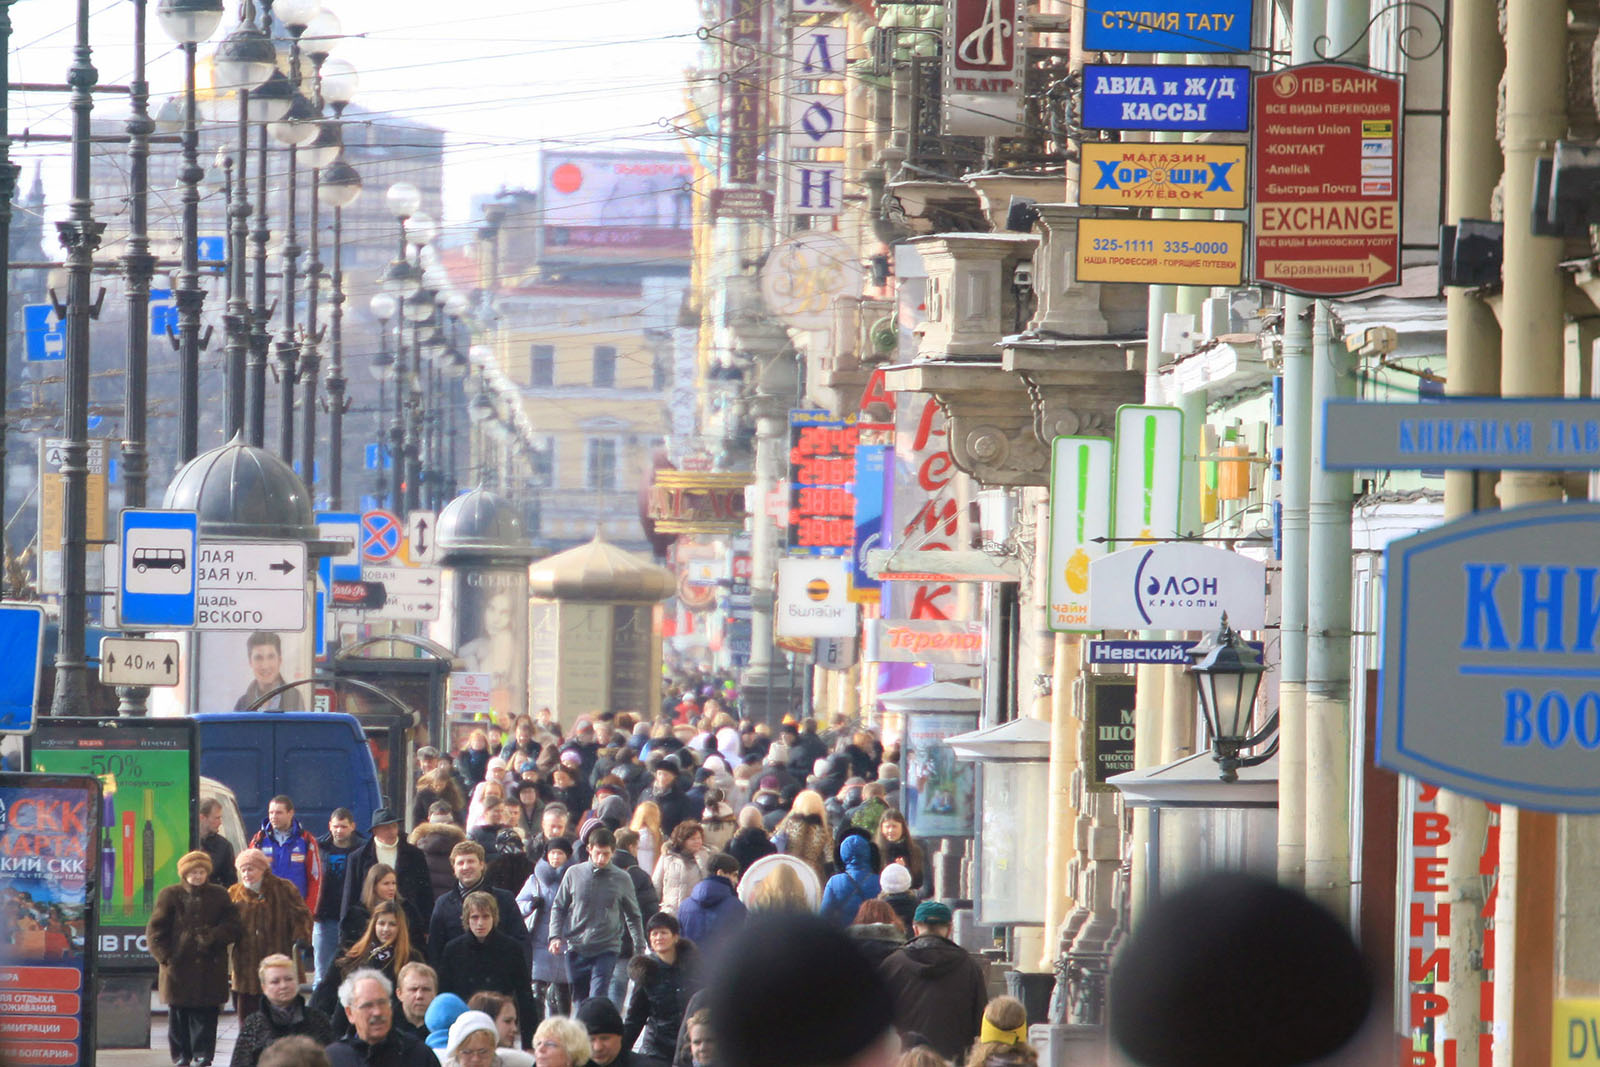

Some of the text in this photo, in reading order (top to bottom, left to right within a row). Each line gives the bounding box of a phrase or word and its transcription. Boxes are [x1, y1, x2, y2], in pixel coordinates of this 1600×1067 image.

[1102, 11, 1235, 33] СТУДИЯ ТАТУ
[954, 78, 1014, 93] ТЕАТР
[1094, 77, 1236, 100] АВИА и Ж/Д
[1301, 78, 1378, 93] ПВ-БАНК
[797, 0, 834, 208] ЛОН
[1265, 104, 1287, 114] ВСЕ
[1289, 104, 1322, 115] ВИДЫ
[1121, 102, 1207, 121] КАССЫ
[1318, 124, 1351, 135] Union
[1123, 153, 1206, 163] МАГАЗИН
[1121, 189, 1205, 200] ПУТЕВОК
[1322, 183, 1357, 195] Почта
[1262, 206, 1393, 230] EXCHANGE
[1093, 238, 1228, 254] 325-1111 335-0000
[1260, 238, 1276, 246] ВСЕ
[1278, 238, 1305, 247] ВИДЫ
[1084, 256, 1107, 265] НАША
[1109, 257, 1158, 266] ПРОФЕССИЯ
[1164, 259, 1200, 268] ГОРЯЩИЕ
[1274, 262, 1372, 277] Караванная 11
[1400, 419, 1533, 453] КНИЖНАЯ
[236, 570, 257, 584] ул.
[1052, 602, 1088, 614] чайн
[1057, 614, 1088, 625] лож
[886, 626, 982, 654] Теремо
[1094, 645, 1190, 662] Невский,
[124, 655, 143, 669] 40
[8, 798, 87, 833] СКК
[47, 859, 86, 873] СКК
[14, 994, 55, 1004] ОТДЫХА
